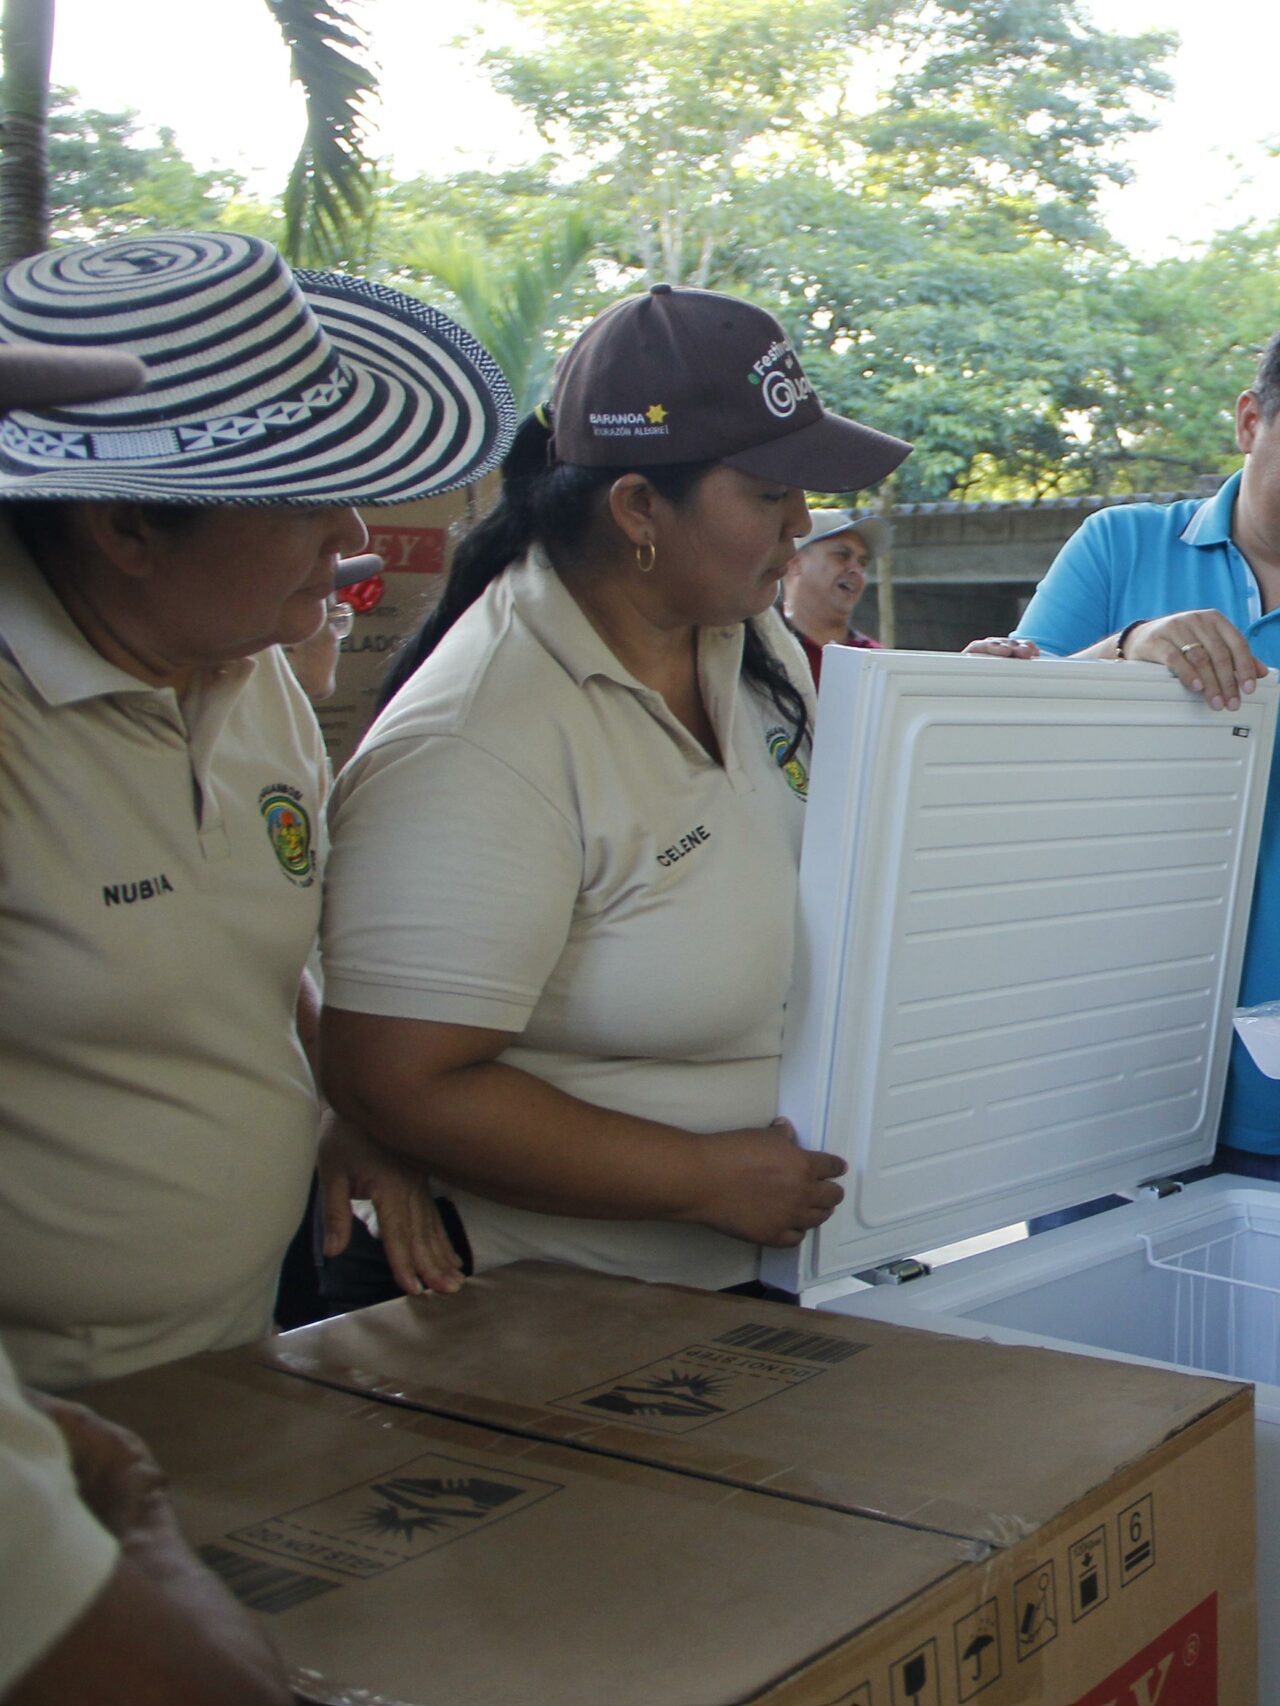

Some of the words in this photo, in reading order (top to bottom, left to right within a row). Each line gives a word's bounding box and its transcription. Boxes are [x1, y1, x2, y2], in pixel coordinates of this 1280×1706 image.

[589, 411, 645, 425] BARANOA
[656, 824, 711, 868] CELENE
[102, 873, 174, 907] NUBIA
[1129, 1511, 1142, 1543] 6
